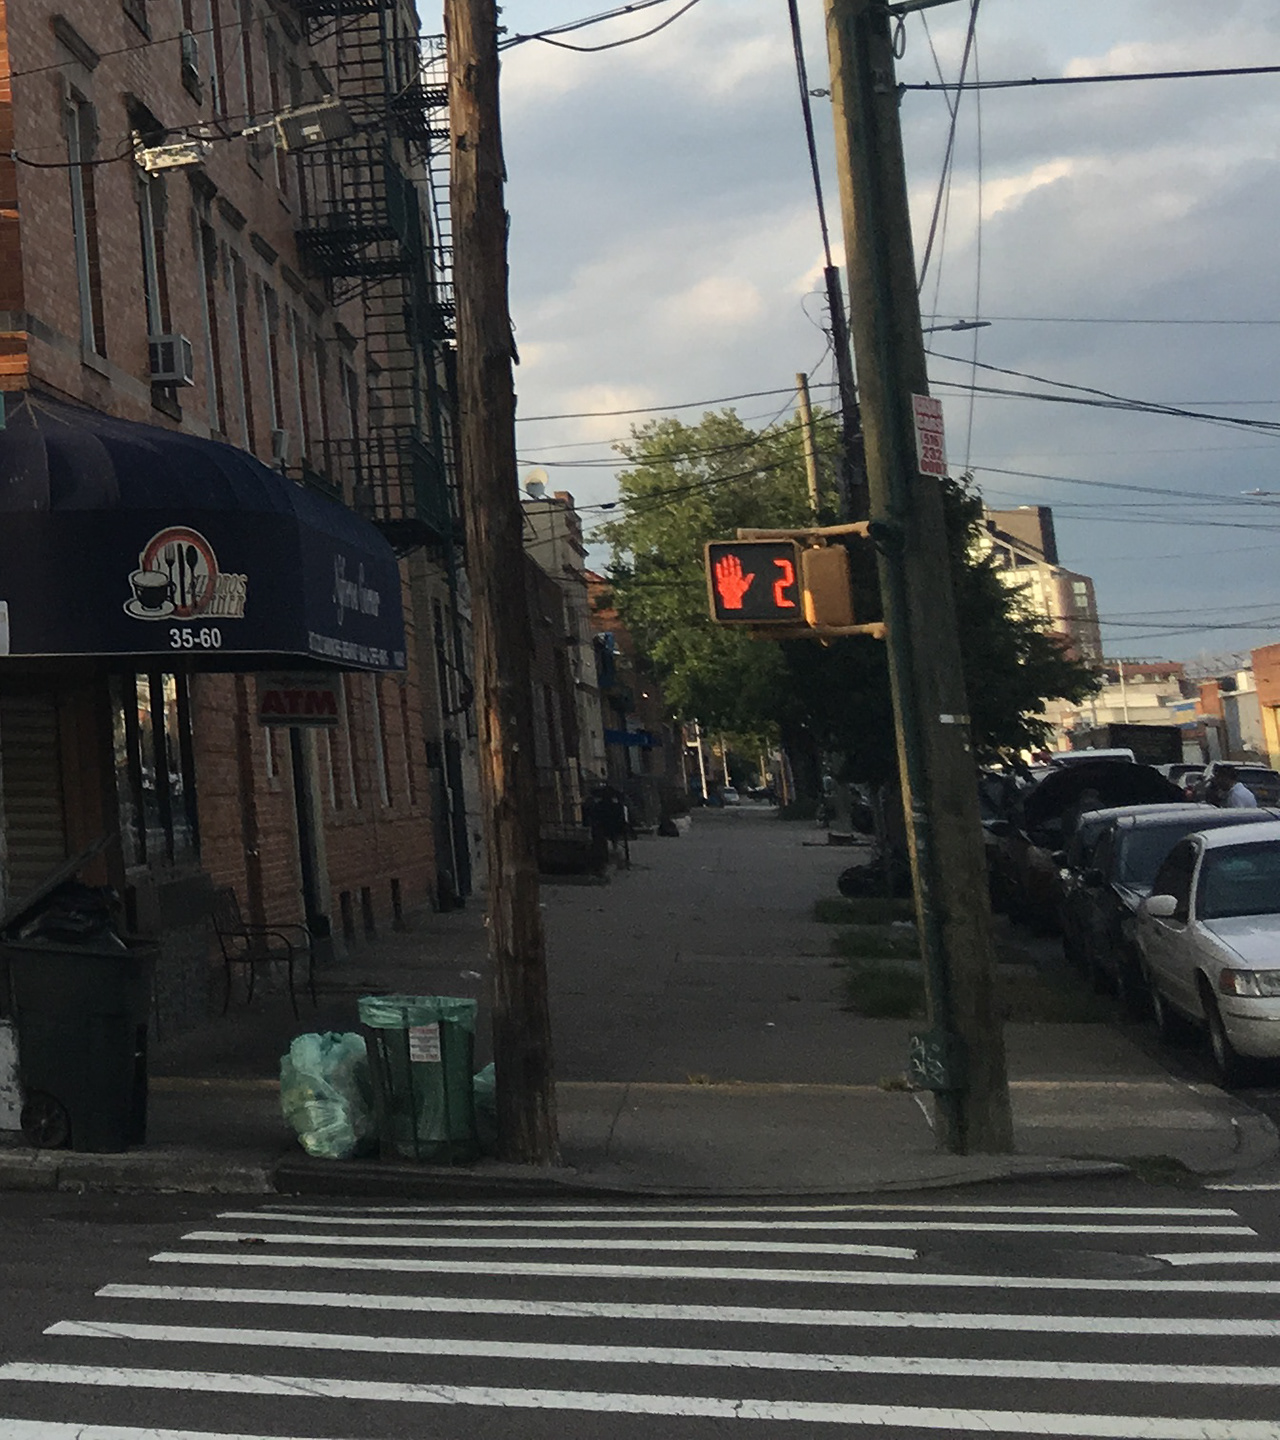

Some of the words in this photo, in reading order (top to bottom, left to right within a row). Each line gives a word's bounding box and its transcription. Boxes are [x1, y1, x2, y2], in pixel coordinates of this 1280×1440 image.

[772, 558, 796, 608] 2
[169, 627, 222, 649] 35-60
[260, 689, 339, 715] ATM
